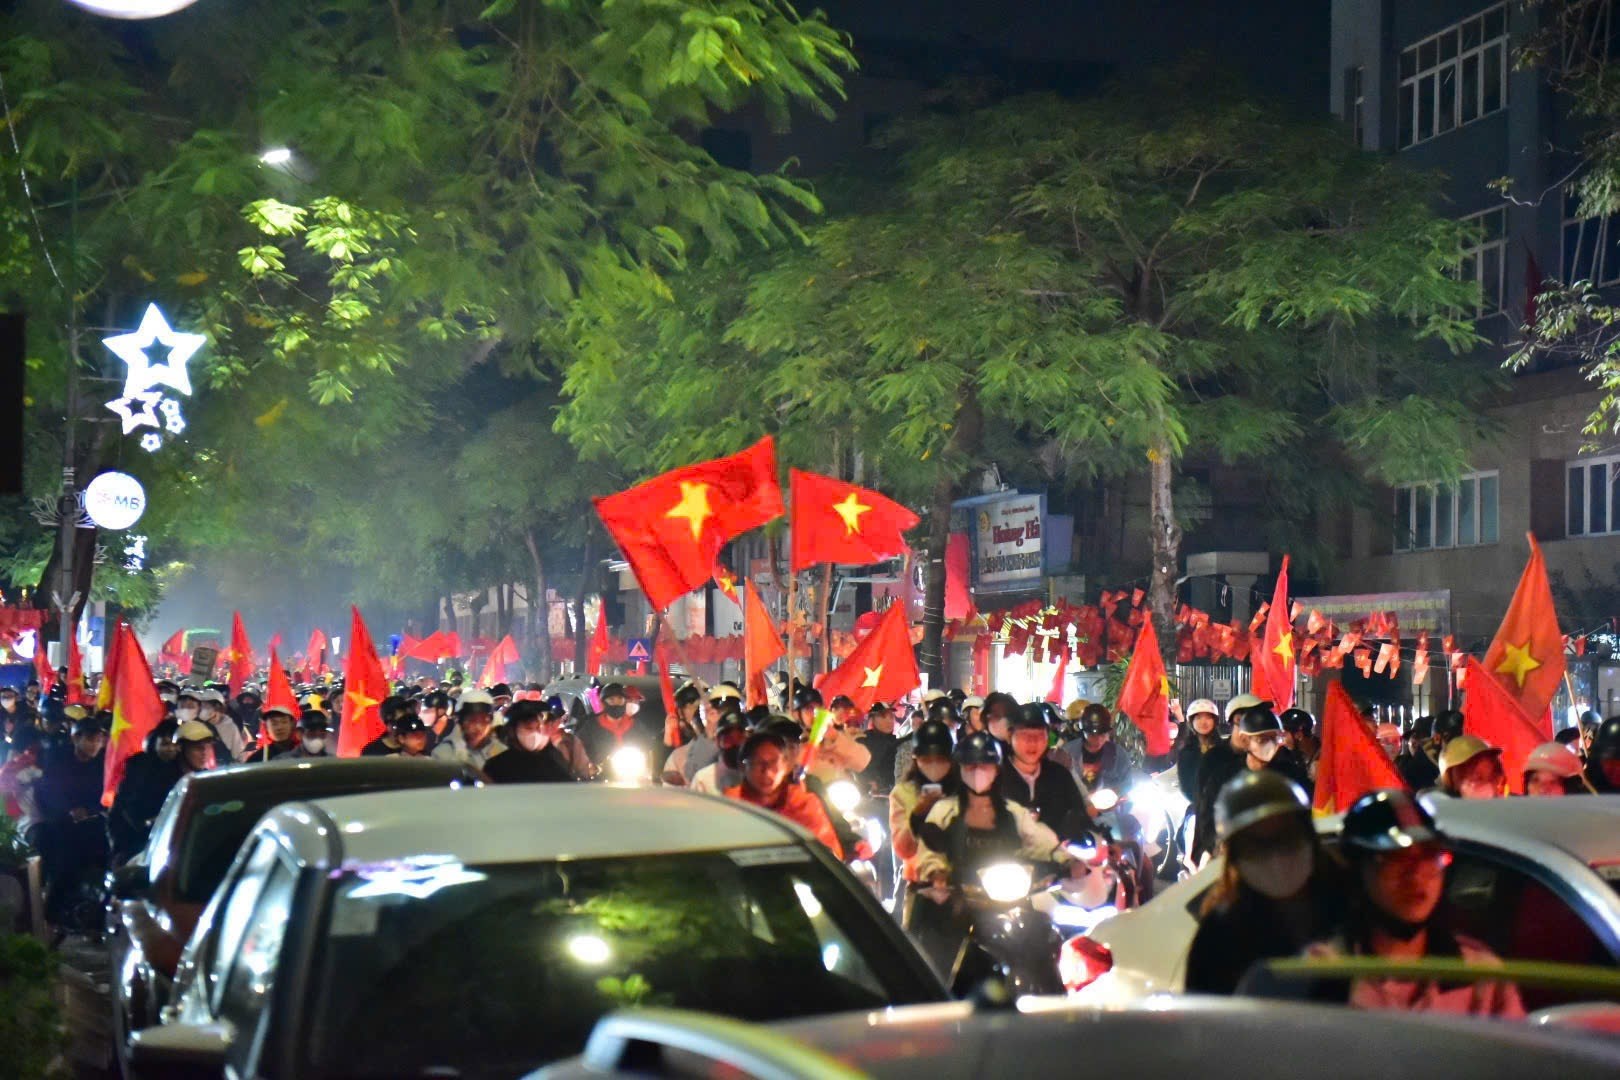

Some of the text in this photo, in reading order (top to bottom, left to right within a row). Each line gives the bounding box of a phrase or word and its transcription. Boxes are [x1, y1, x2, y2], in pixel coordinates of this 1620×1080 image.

[114, 494, 140, 509] MB
[992, 516, 1040, 547] Hoàng Hà
